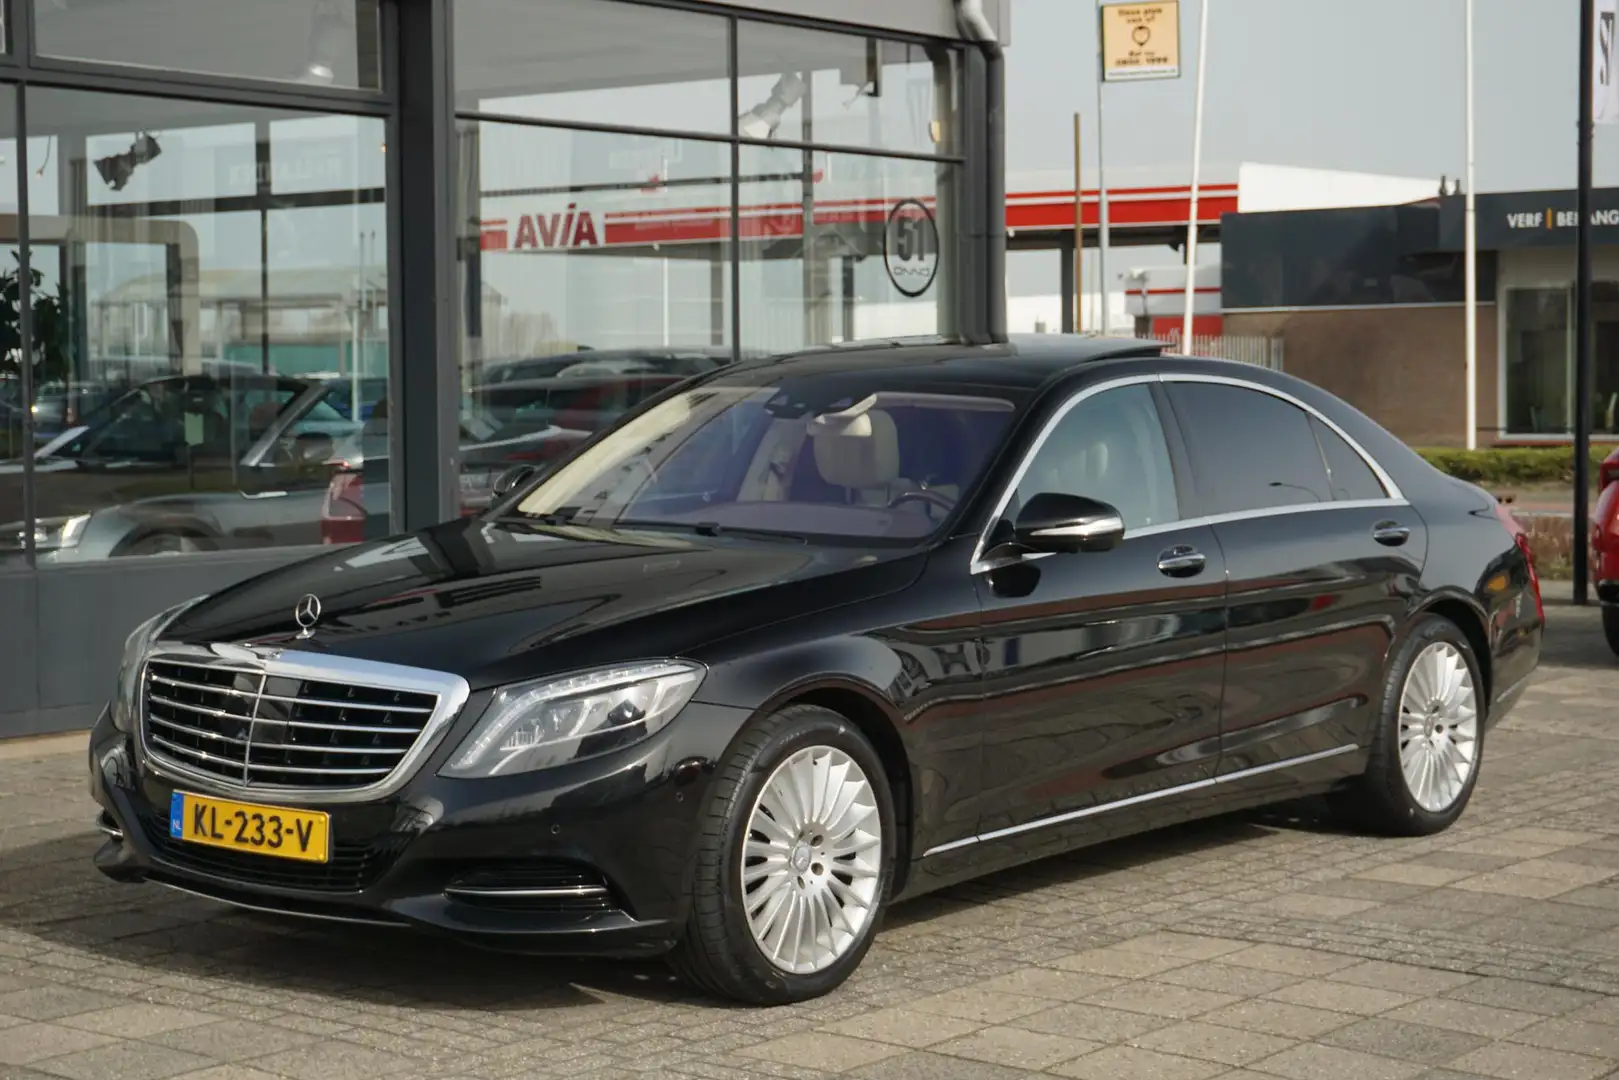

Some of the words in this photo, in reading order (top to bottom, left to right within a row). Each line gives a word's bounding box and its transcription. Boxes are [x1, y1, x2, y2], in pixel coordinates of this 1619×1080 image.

[898, 215, 924, 262] 51
[1506, 212, 1543, 228] VERF
[193, 803, 313, 852] KL-233-V
